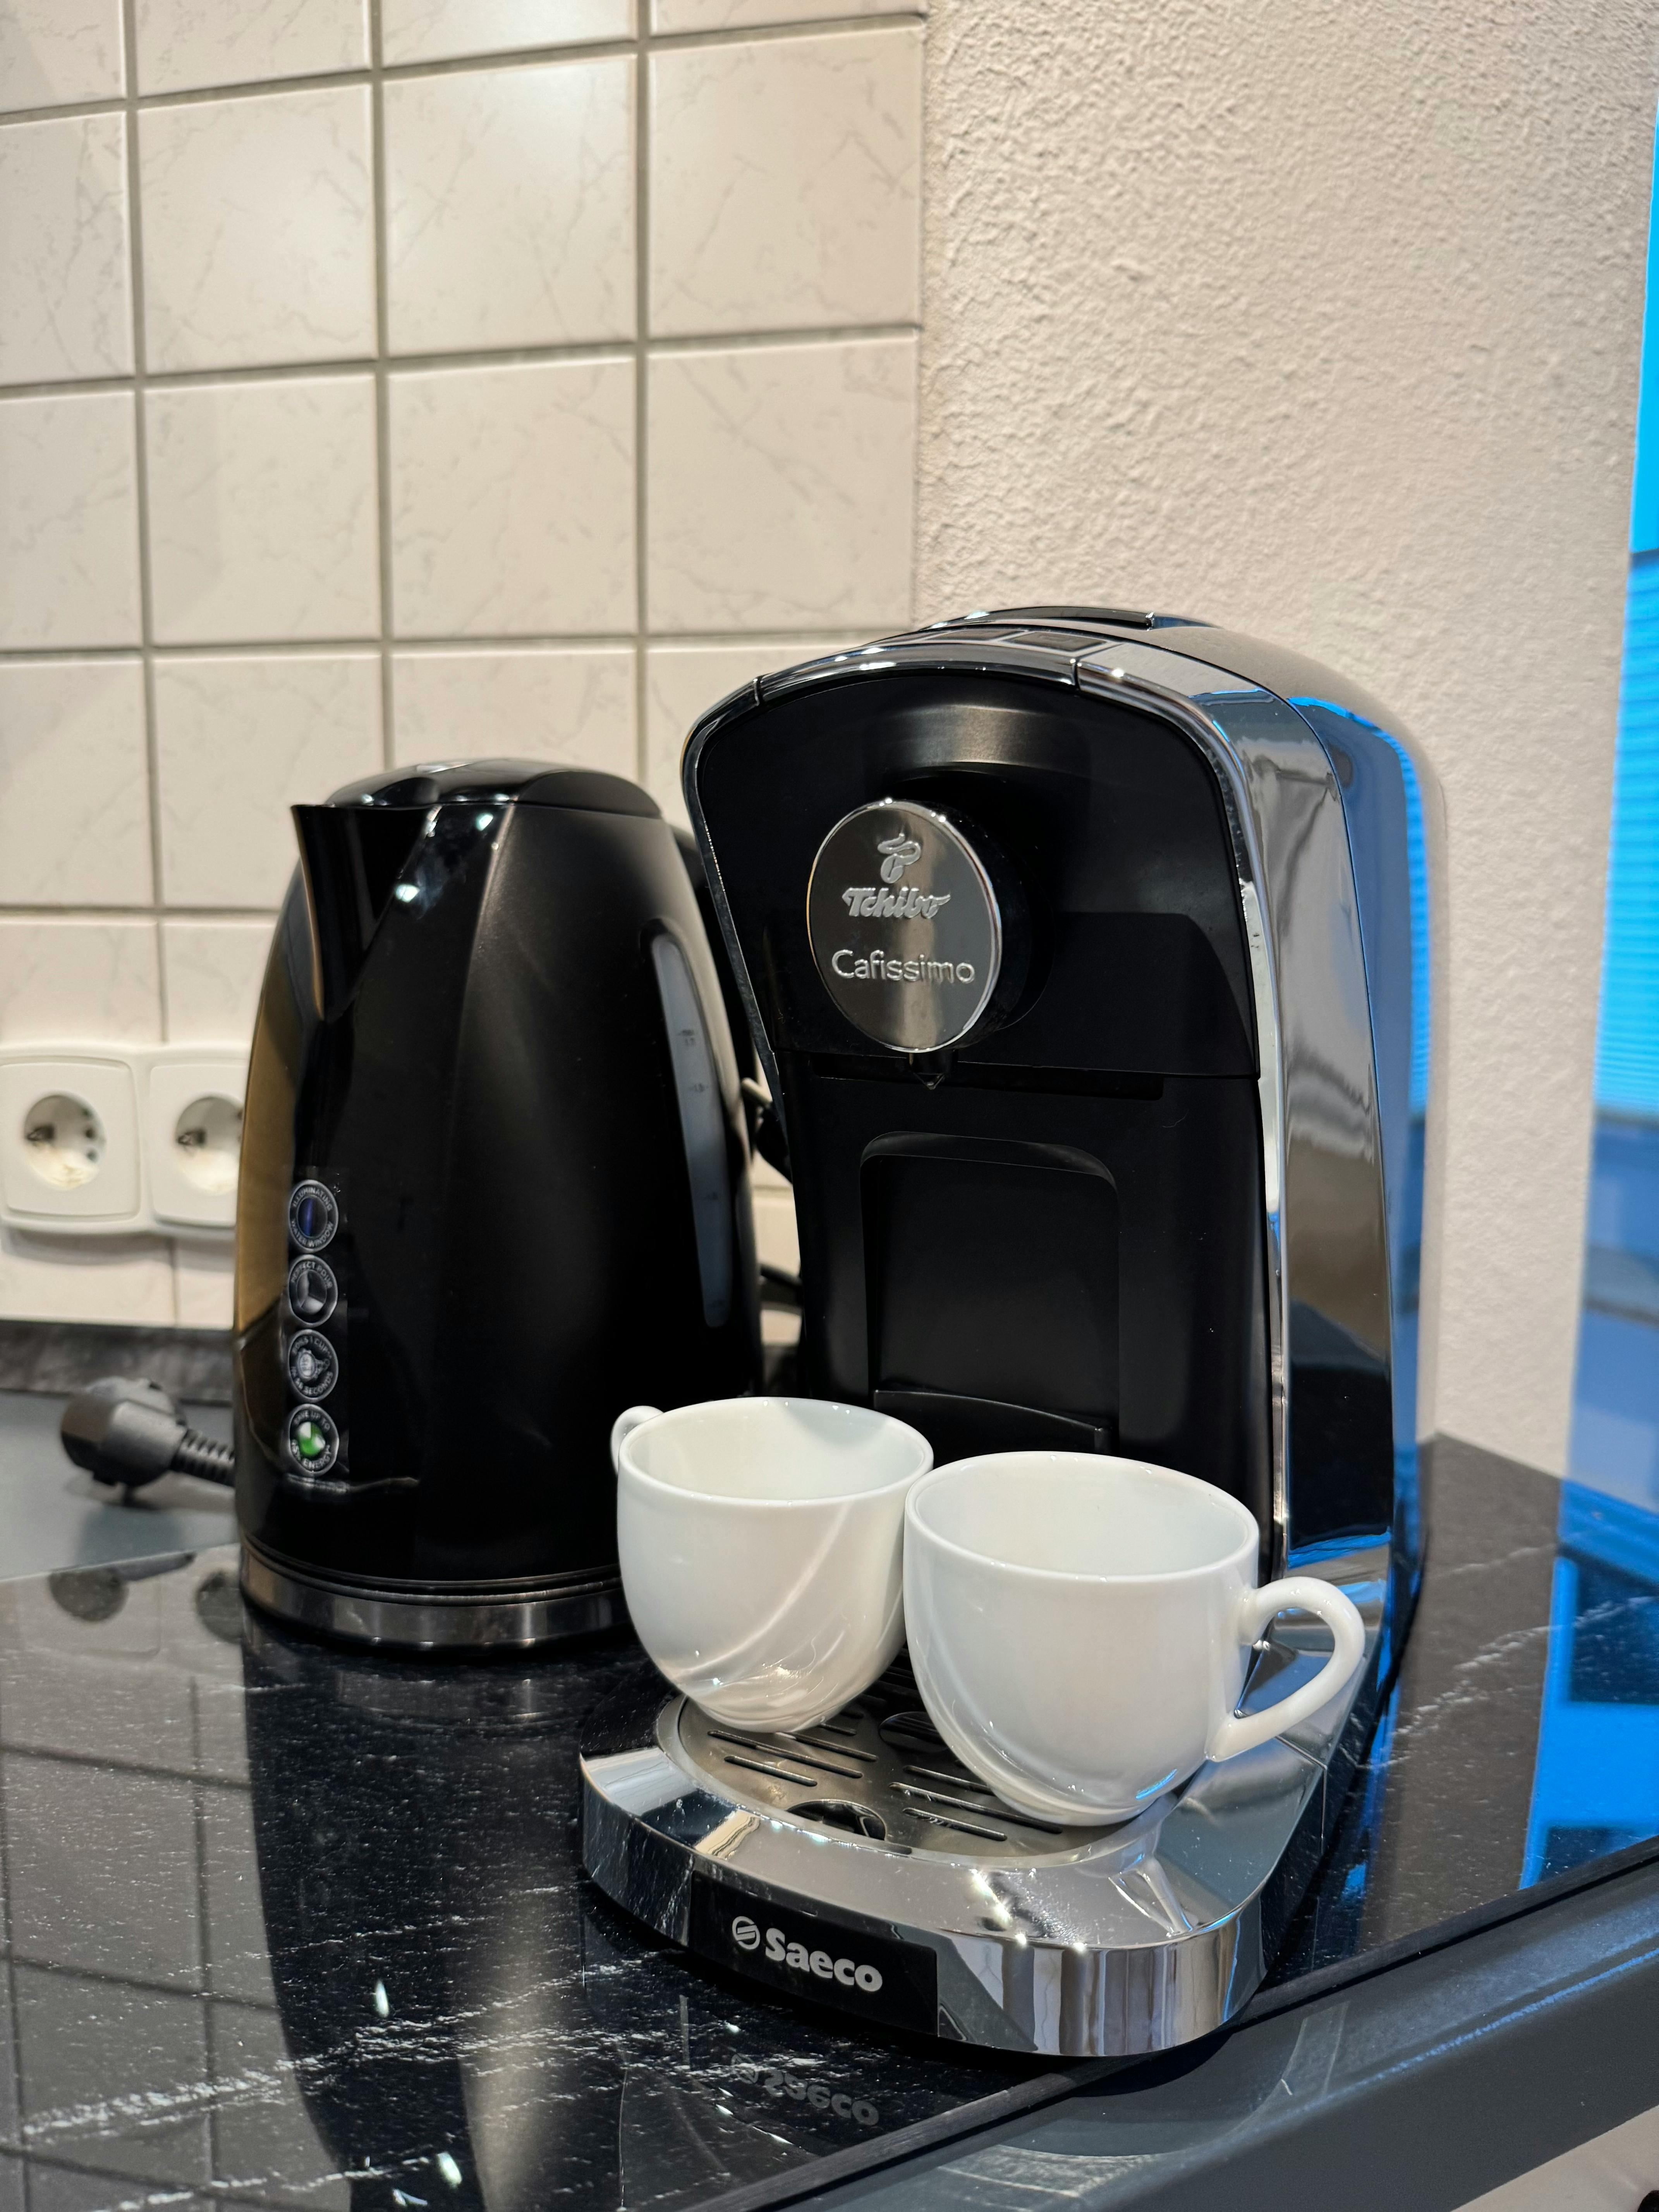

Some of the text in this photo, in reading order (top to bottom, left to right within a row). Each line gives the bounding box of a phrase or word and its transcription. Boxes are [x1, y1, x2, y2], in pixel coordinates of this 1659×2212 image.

[842, 887, 951, 918] Tchibo
[832, 950, 975, 983] Cafissimo
[292, 1187, 332, 1211] ILLUMINATING
[316, 1265, 333, 1289] POUR
[302, 1371, 333, 1395] SECONDS
[766, 1928, 883, 1992] Saeco
